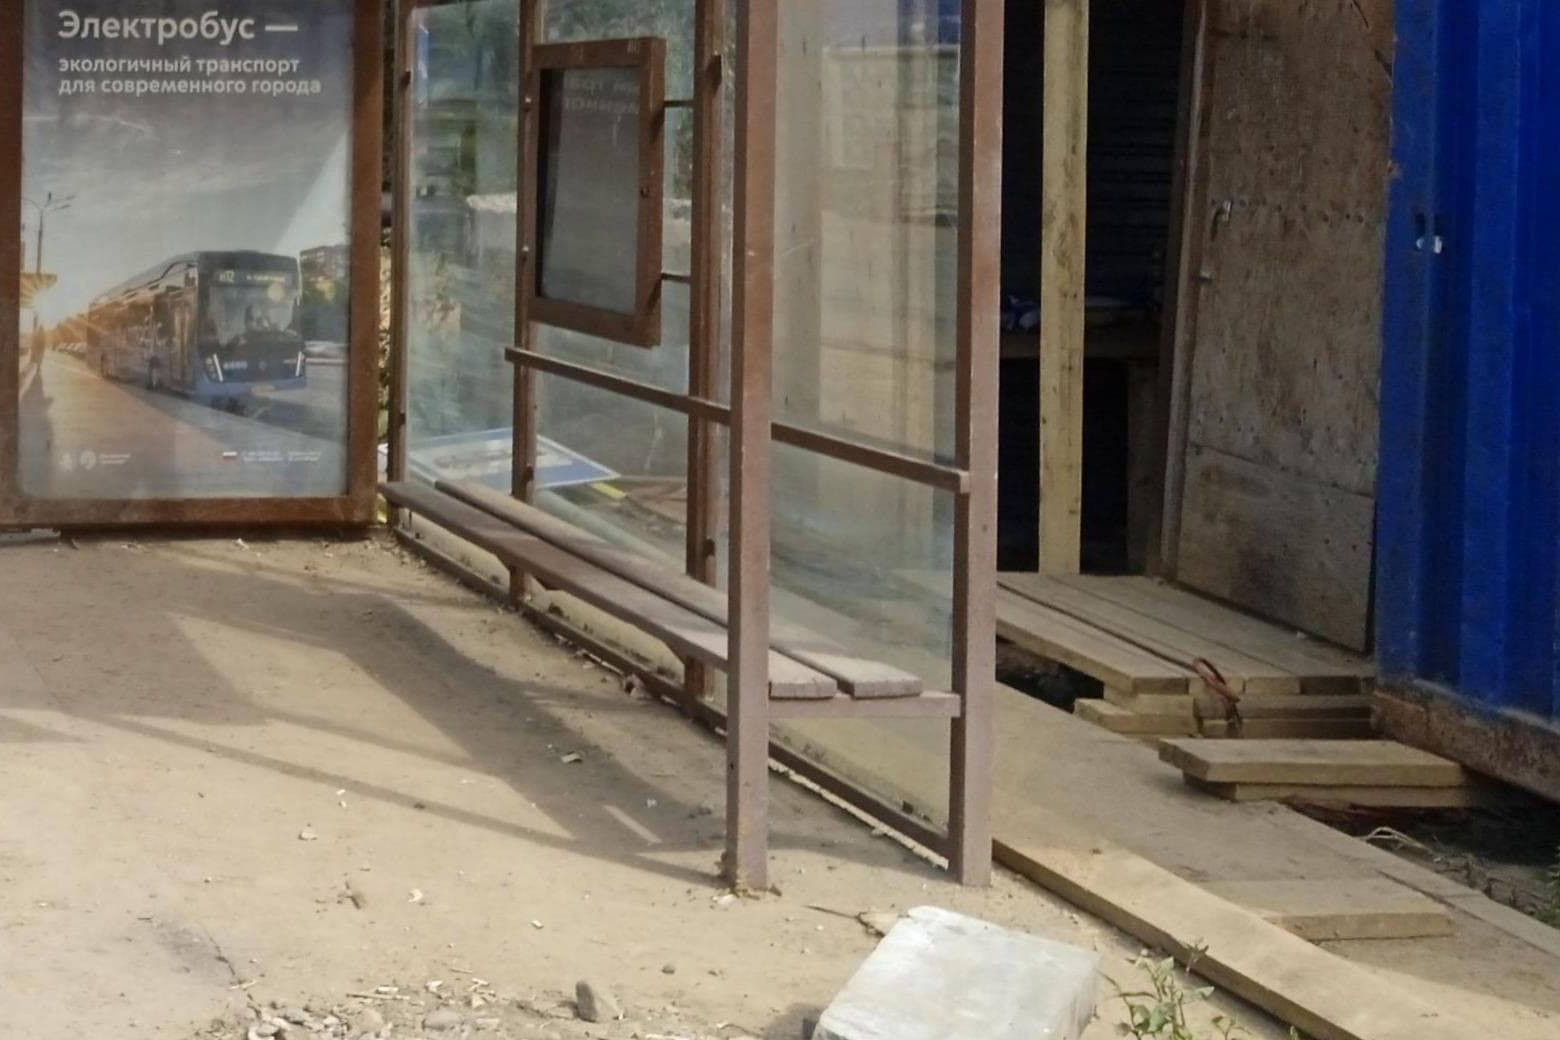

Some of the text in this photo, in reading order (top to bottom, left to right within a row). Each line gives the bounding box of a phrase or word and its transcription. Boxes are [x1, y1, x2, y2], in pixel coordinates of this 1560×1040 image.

[58, 10, 255, 45] Электробус
[58, 56, 300, 75] экологичный транспорт
[58, 79, 322, 96] для современного города
